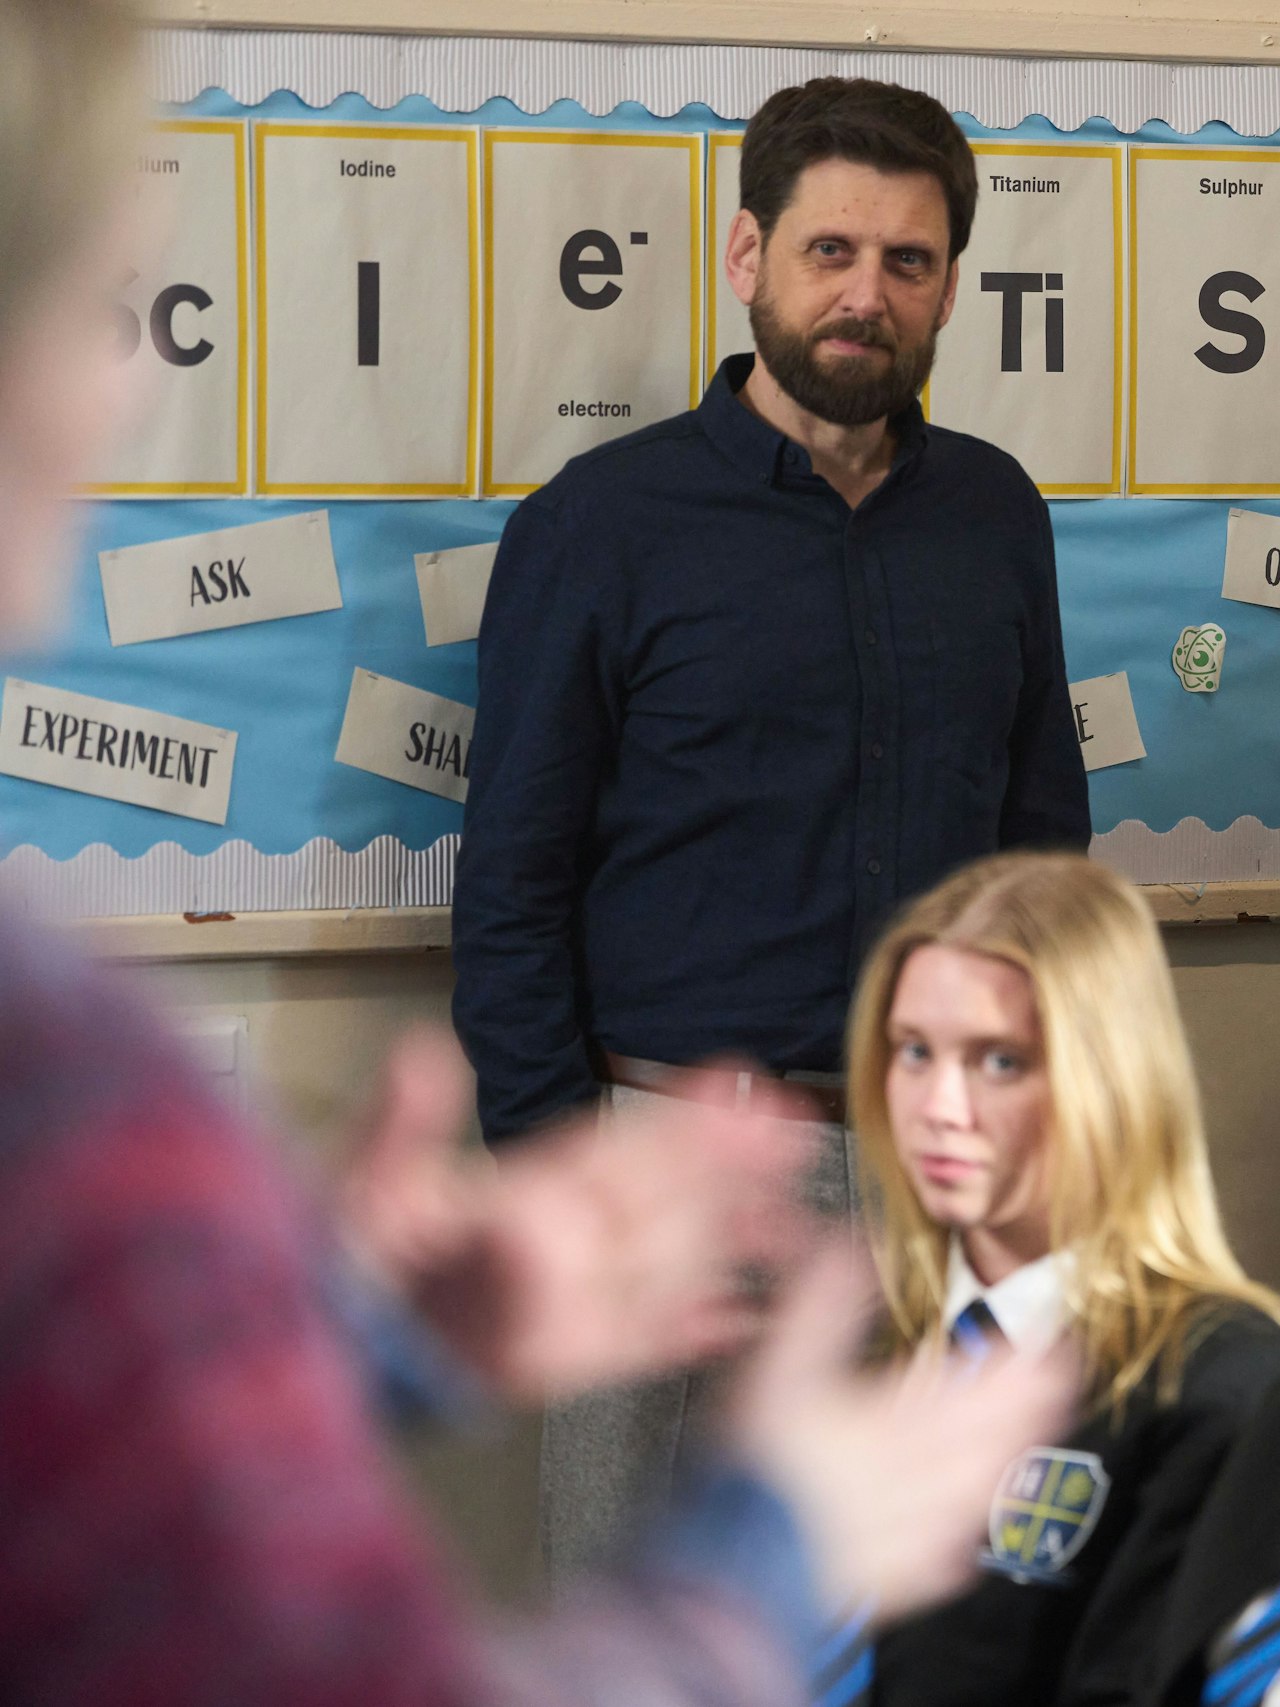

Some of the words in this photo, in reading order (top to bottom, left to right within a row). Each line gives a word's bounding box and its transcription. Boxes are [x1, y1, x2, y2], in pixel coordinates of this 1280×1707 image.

[340, 159, 396, 178] Iodine
[989, 175, 1061, 194] Titanium
[1199, 178, 1264, 198] Sulphur
[357, 261, 380, 366] I
[981, 271, 1064, 373] Ti
[1194, 270, 1266, 374] S
[557, 399, 632, 418] electron
[189, 557, 251, 608] ASK
[19, 704, 218, 788] EXPERIMENT
